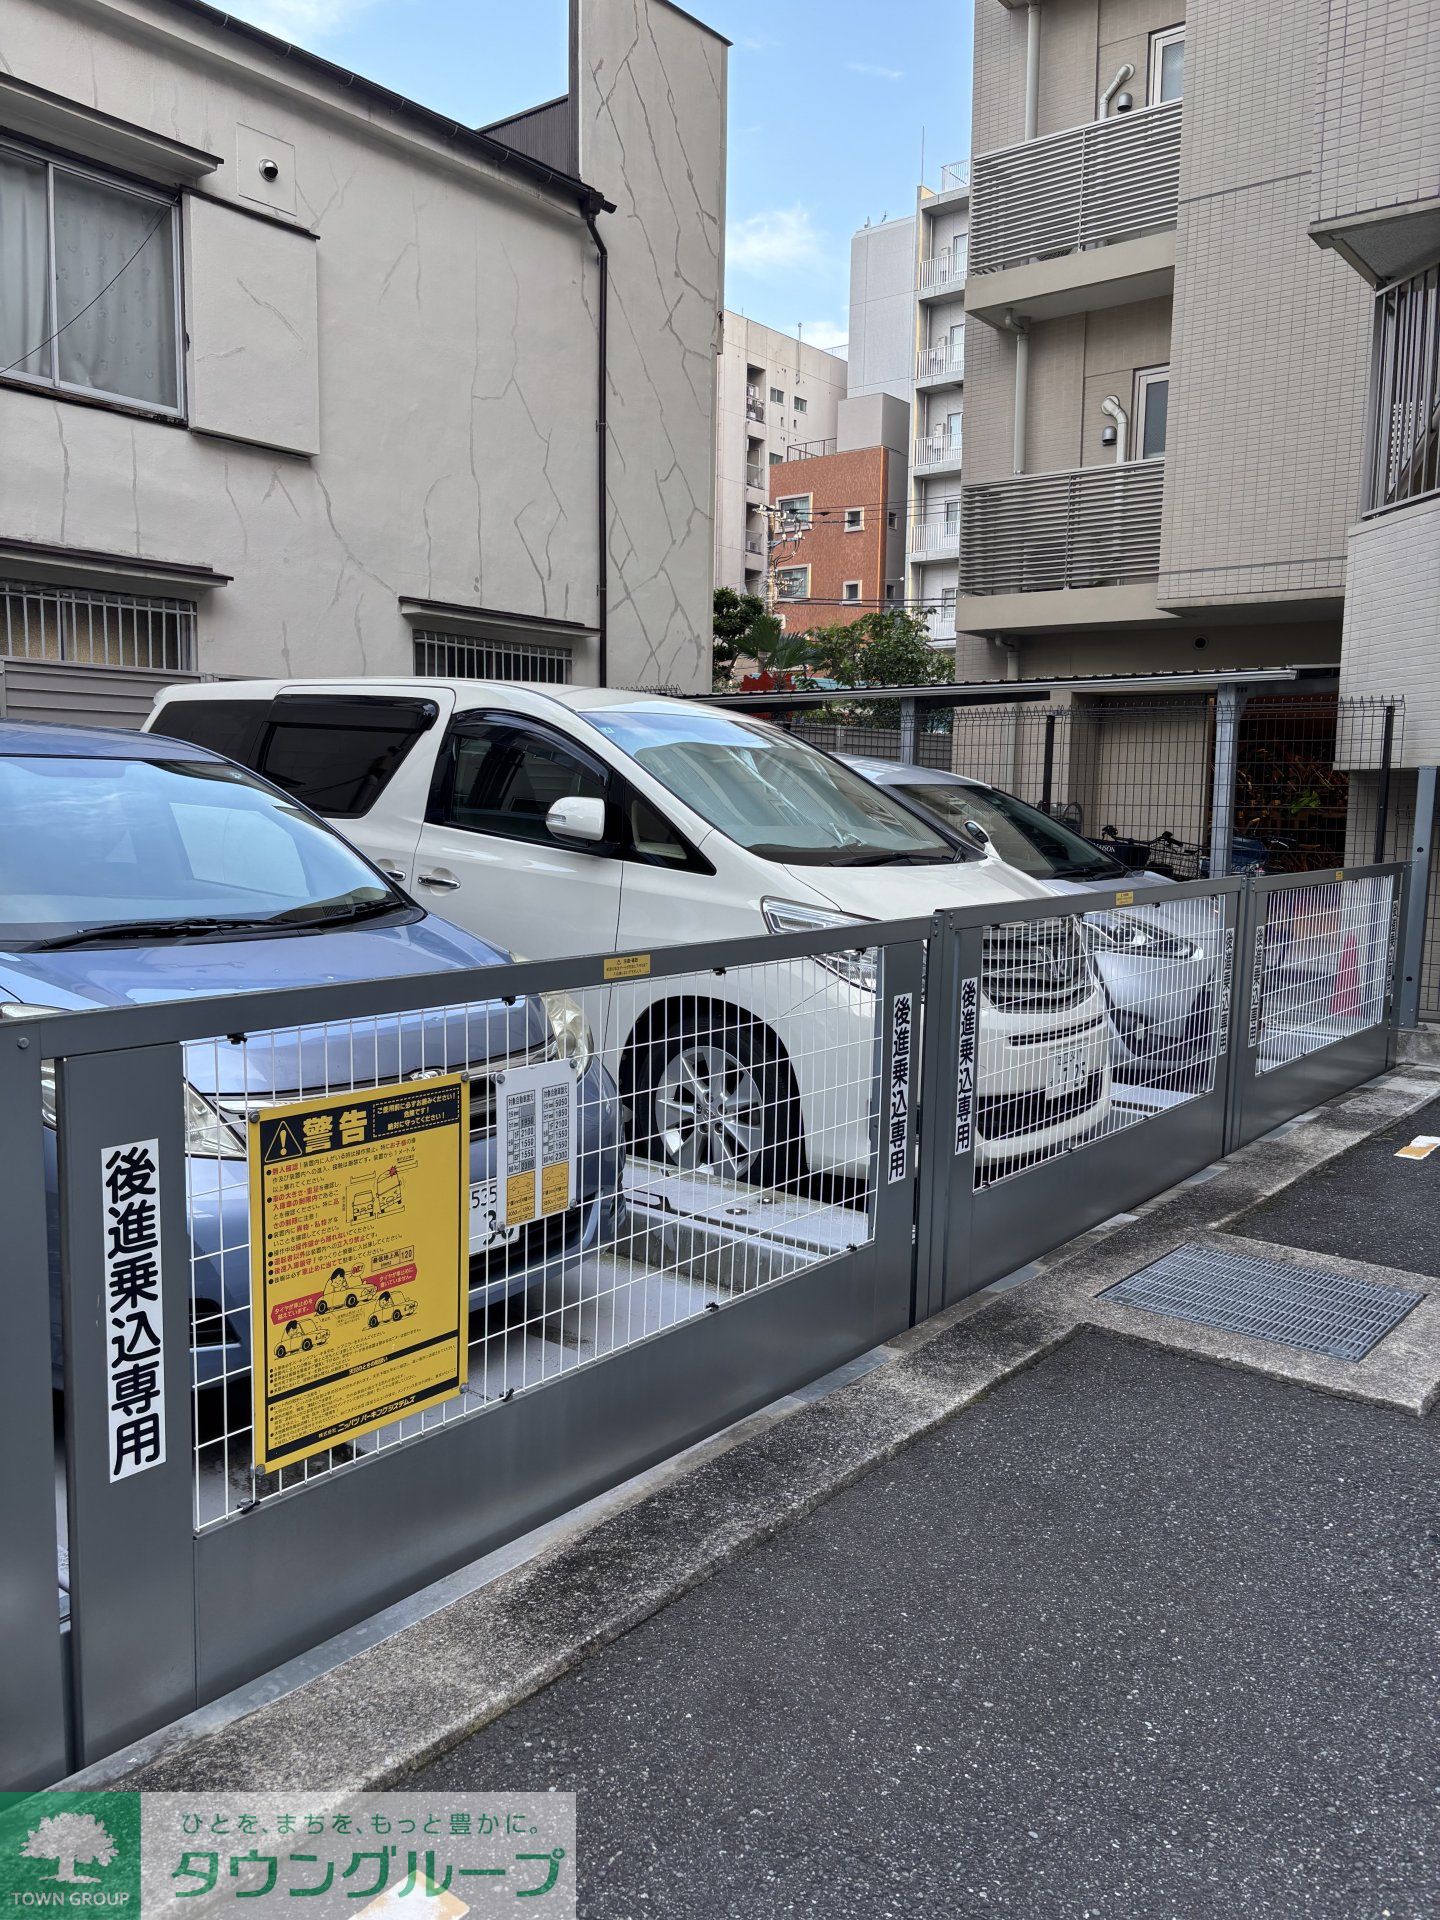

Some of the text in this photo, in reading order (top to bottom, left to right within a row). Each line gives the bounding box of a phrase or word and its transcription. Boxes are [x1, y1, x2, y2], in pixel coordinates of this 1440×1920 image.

[1219, 930, 1233, 1053] 後進乗込専用
[1249, 928, 1264, 1046] 後進乗込専用
[889, 996, 911, 1181] 後進乗込専用
[956, 980, 976, 1152] 後進乗込専用
[302, 1109, 368, 1153] 警告
[520, 1127, 534, 1137] 2100
[105, 1146, 161, 1475] 後進乗込専用
[402, 1249, 412, 1259] 120
